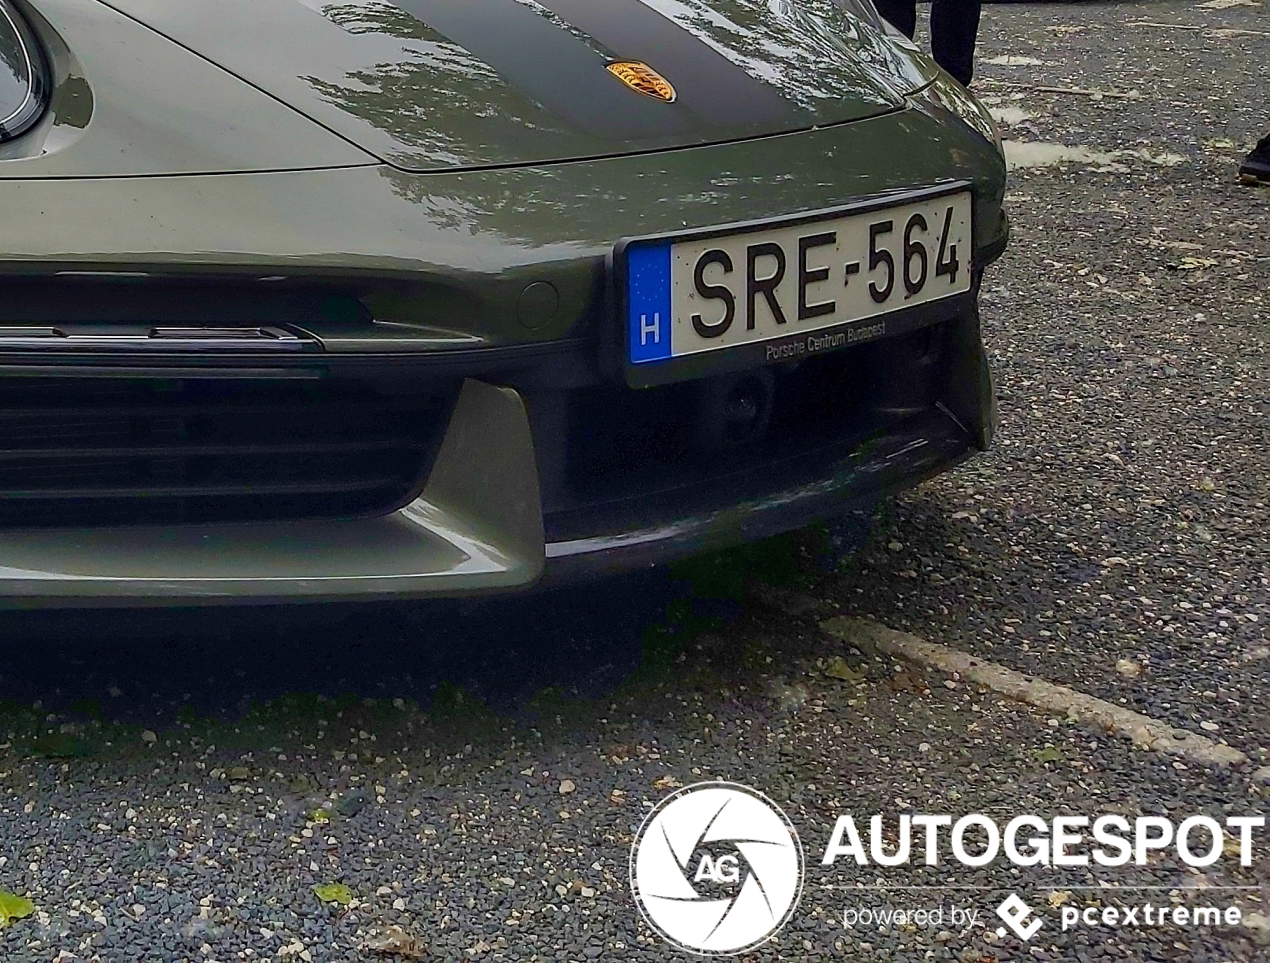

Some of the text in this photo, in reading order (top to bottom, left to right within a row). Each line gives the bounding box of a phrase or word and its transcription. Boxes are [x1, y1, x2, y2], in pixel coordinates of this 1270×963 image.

[640, 206, 960, 346] H SRE-564
[766, 321, 886, 360] Porsche Centrum Budapest
